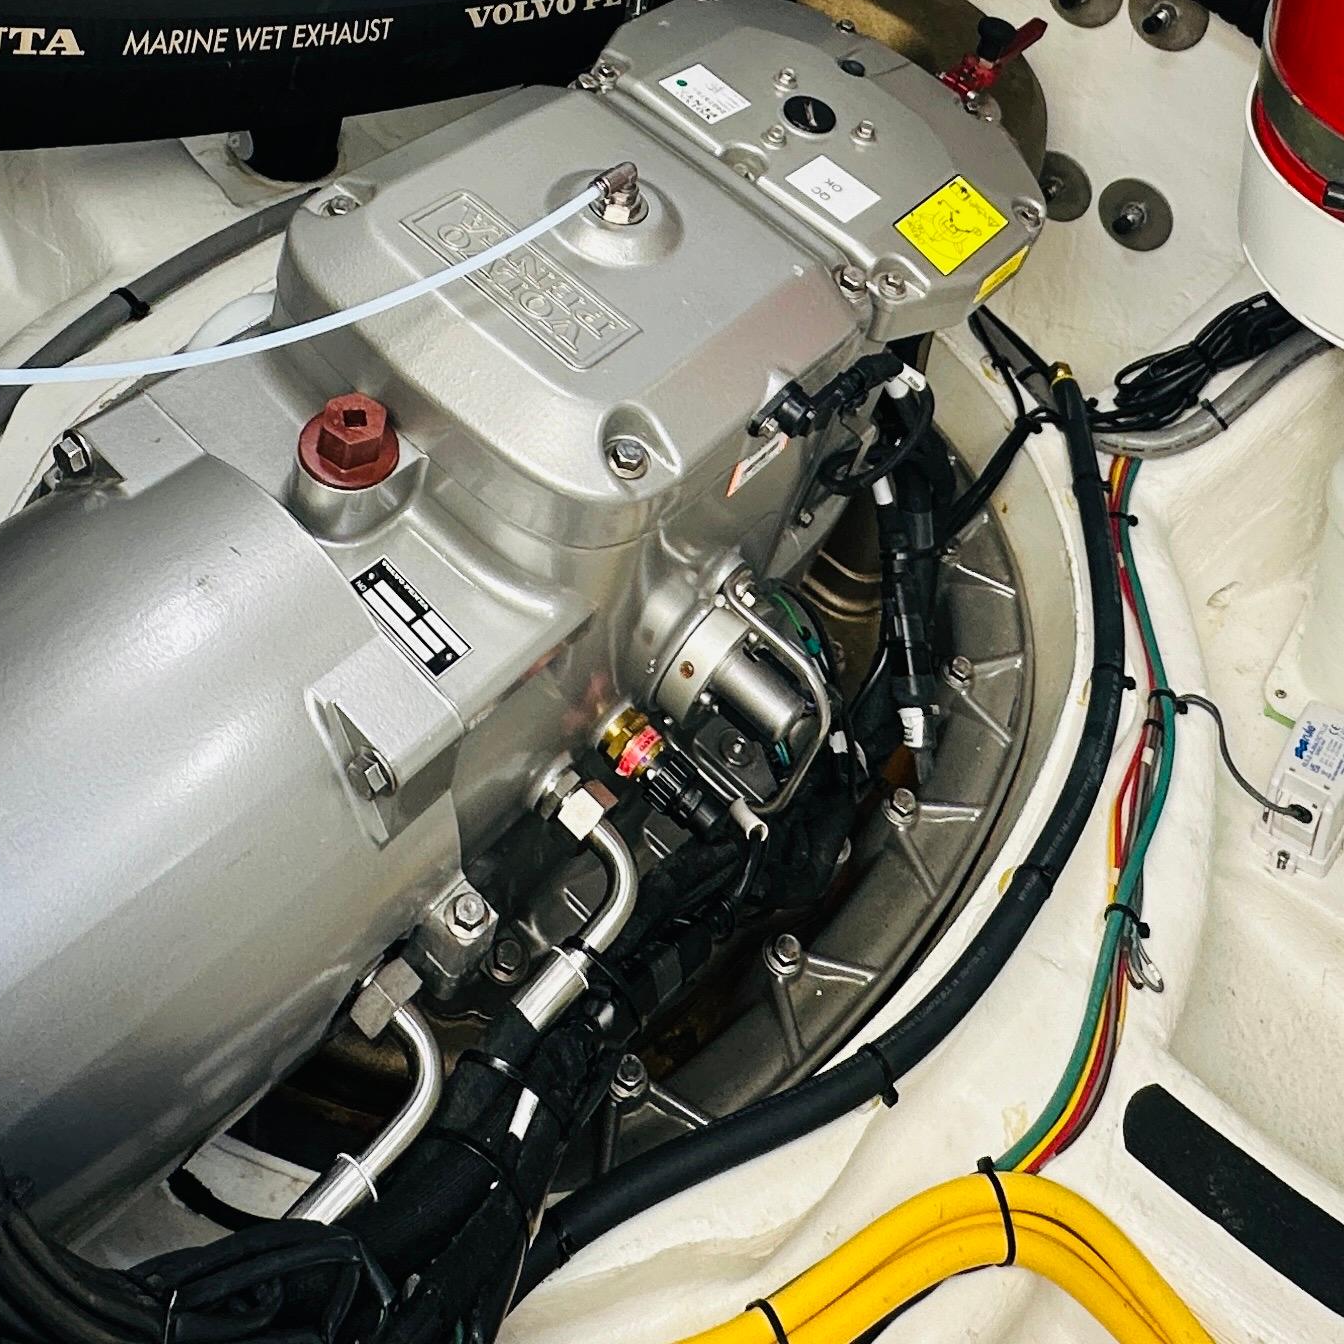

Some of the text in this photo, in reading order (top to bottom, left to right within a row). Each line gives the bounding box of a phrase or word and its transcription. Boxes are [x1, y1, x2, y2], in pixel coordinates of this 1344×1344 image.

[122, 29, 228, 56] MARINE
[235, 25, 288, 52] WET
[293, 17, 394, 48] EXHAUST
